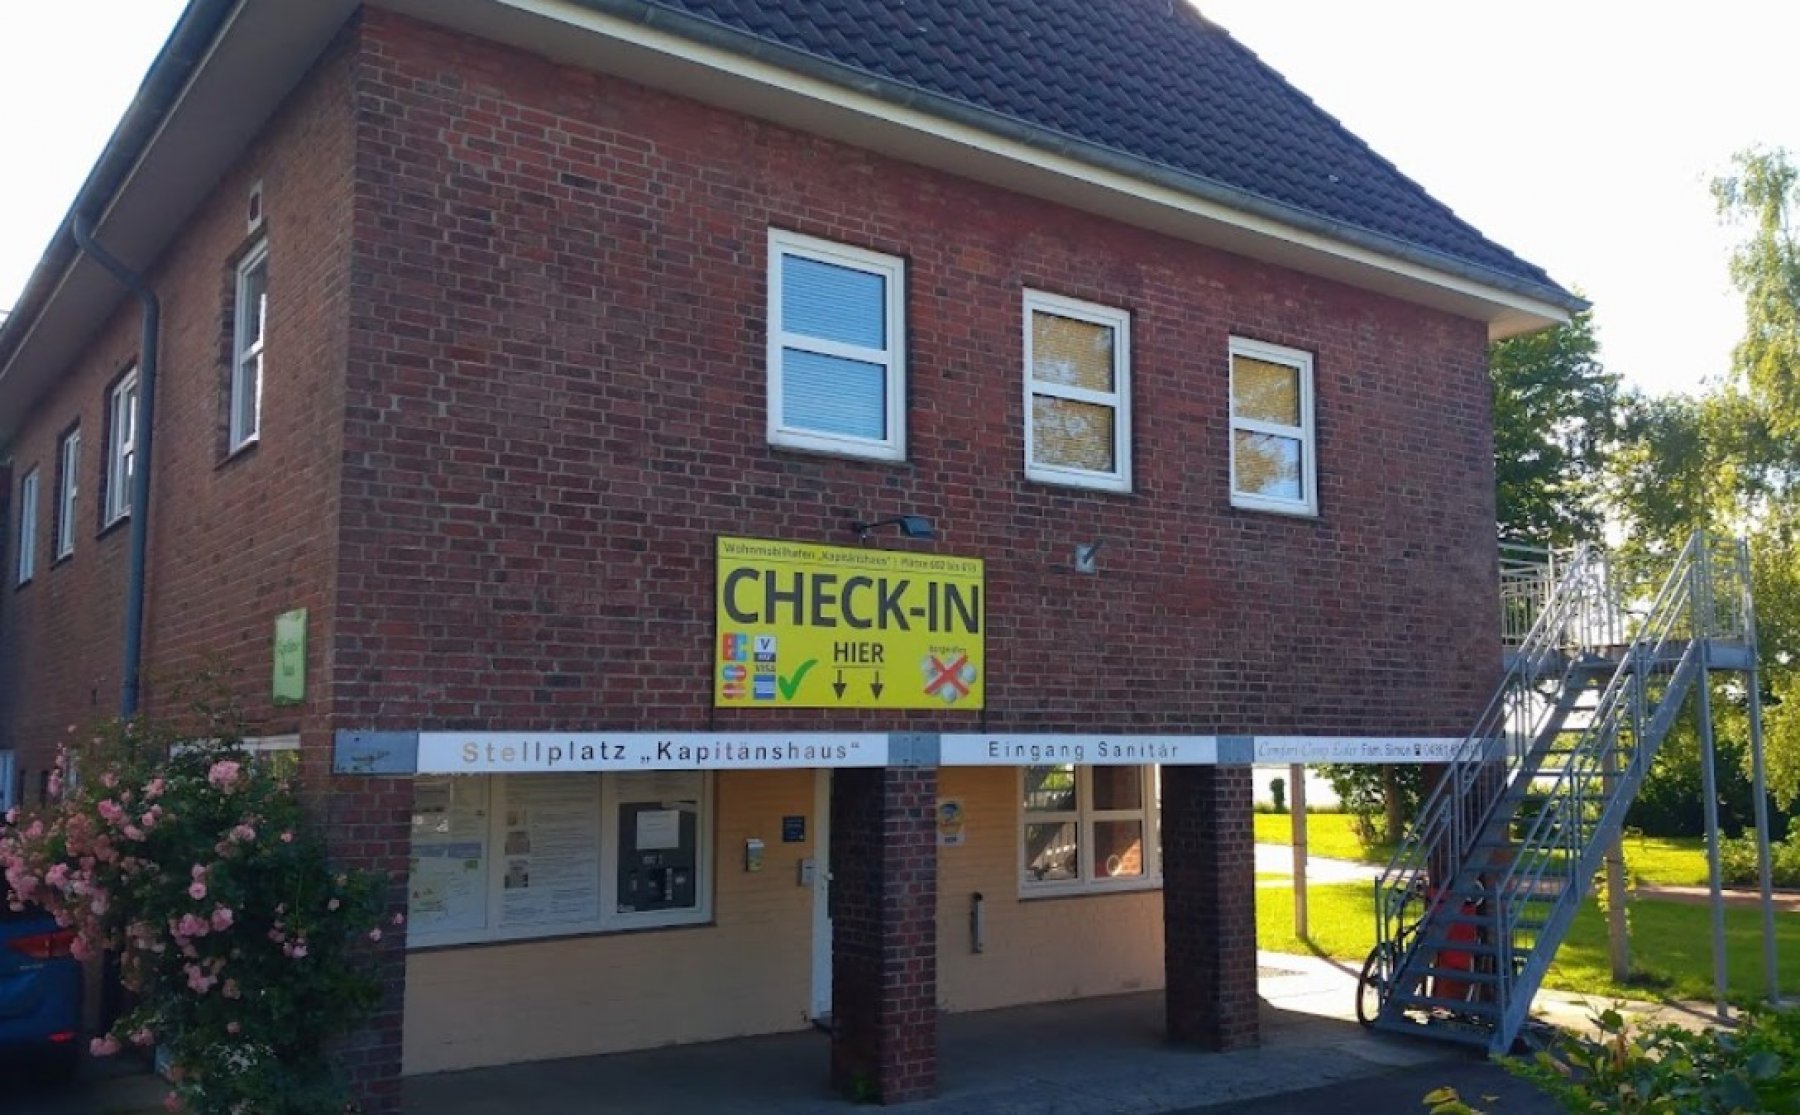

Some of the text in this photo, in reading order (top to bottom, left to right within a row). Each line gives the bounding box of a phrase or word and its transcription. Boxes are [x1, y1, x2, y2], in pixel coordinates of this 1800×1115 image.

[723, 567, 979, 634] CHECK-IN
[834, 641, 885, 663] HIER
[462, 740, 860, 767] Stellplatz „Kapitänshaus“
[988, 740, 1179, 761] Eingang Sanitär
